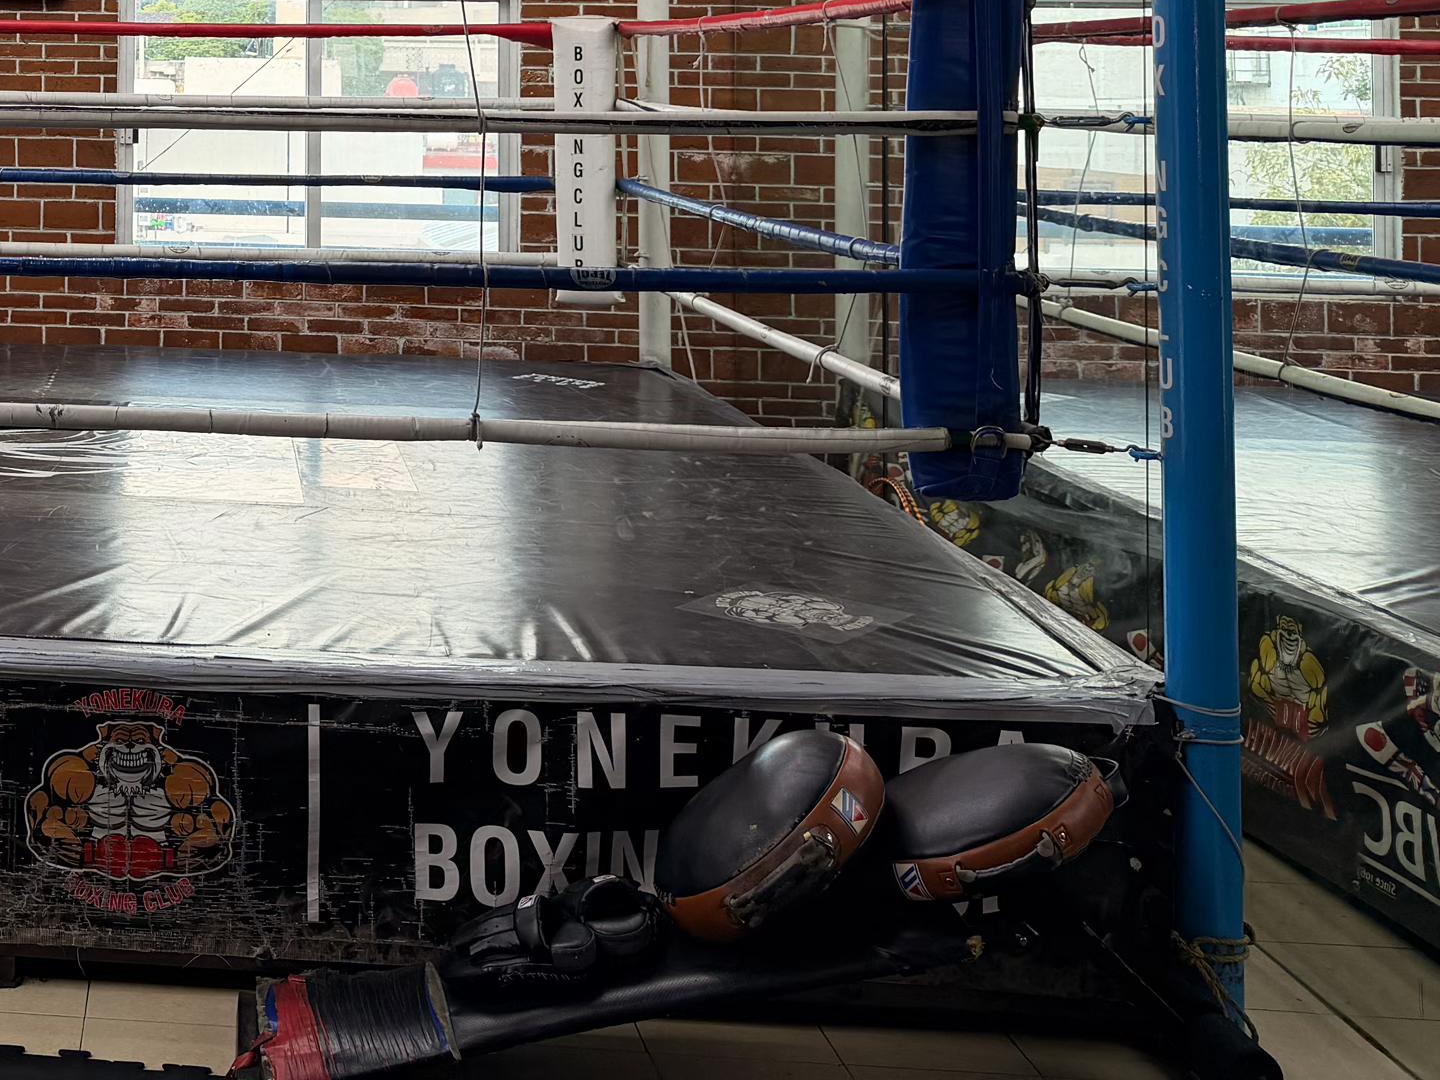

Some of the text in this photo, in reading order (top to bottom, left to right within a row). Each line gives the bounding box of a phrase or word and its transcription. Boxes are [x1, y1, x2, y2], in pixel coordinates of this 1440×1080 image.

[573, 46, 584, 179] BOXNG
[75, 688, 187, 726] YONEKURA
[412, 709, 1029, 789] YONER
[63, 871, 196, 914] BOXING CLUB
[413, 823, 660, 907] BOXIN
